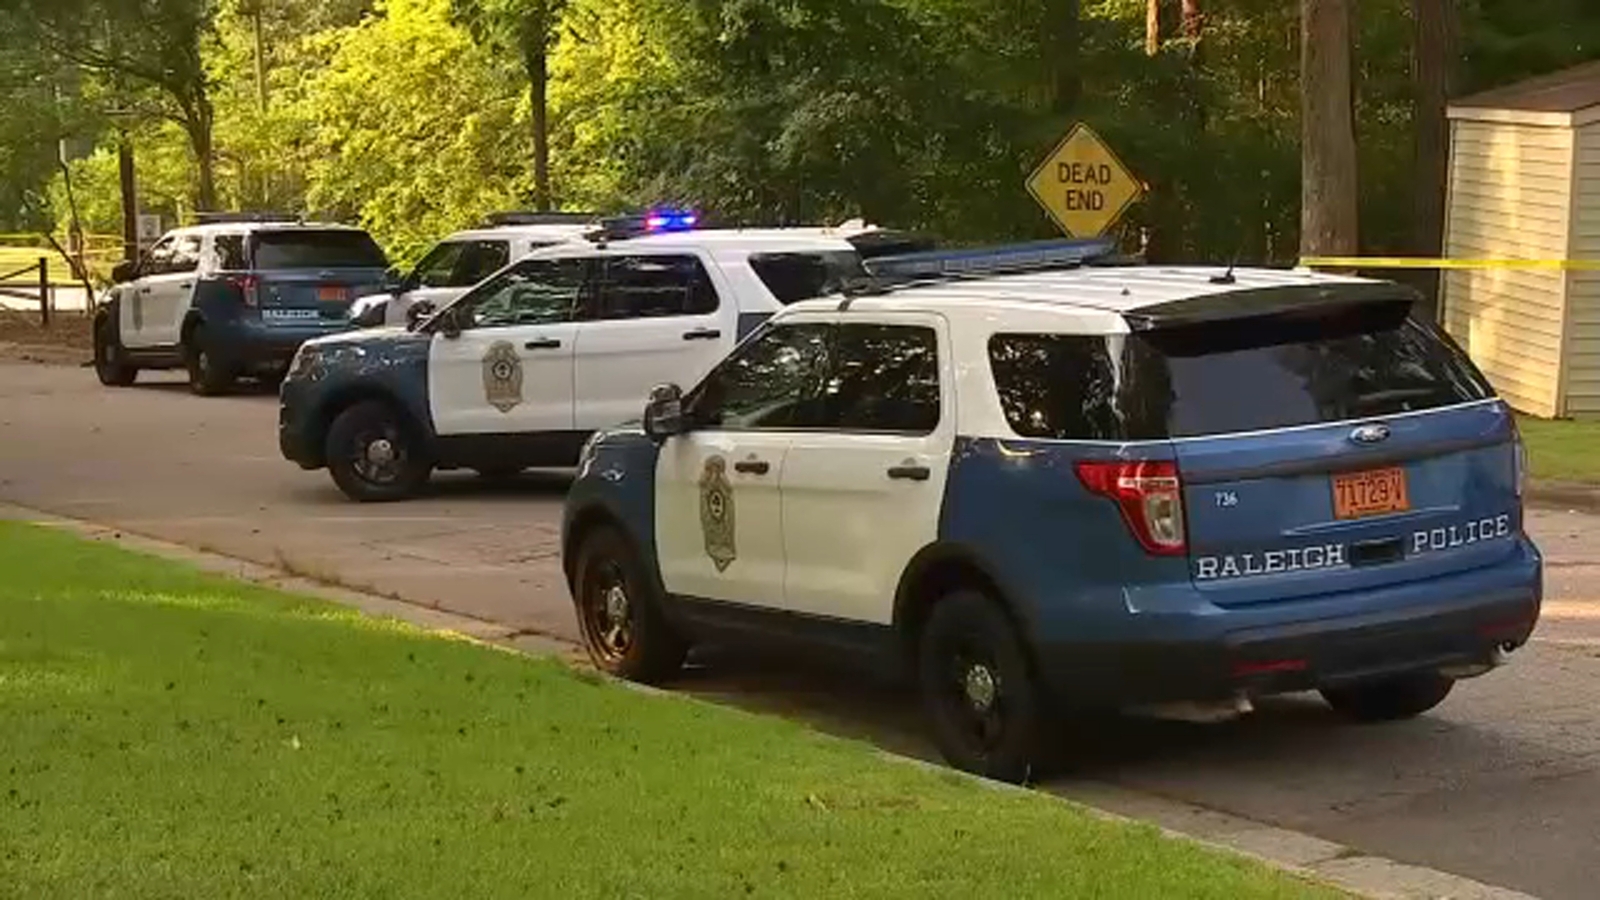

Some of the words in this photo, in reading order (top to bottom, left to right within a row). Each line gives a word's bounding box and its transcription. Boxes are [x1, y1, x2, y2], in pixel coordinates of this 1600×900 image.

[1058, 163, 1111, 185] DEAD
[1066, 190, 1104, 211] END
[1214, 491, 1238, 507] 736
[1196, 544, 1344, 579] RALEIGH
[1413, 515, 1510, 552] POLICE
